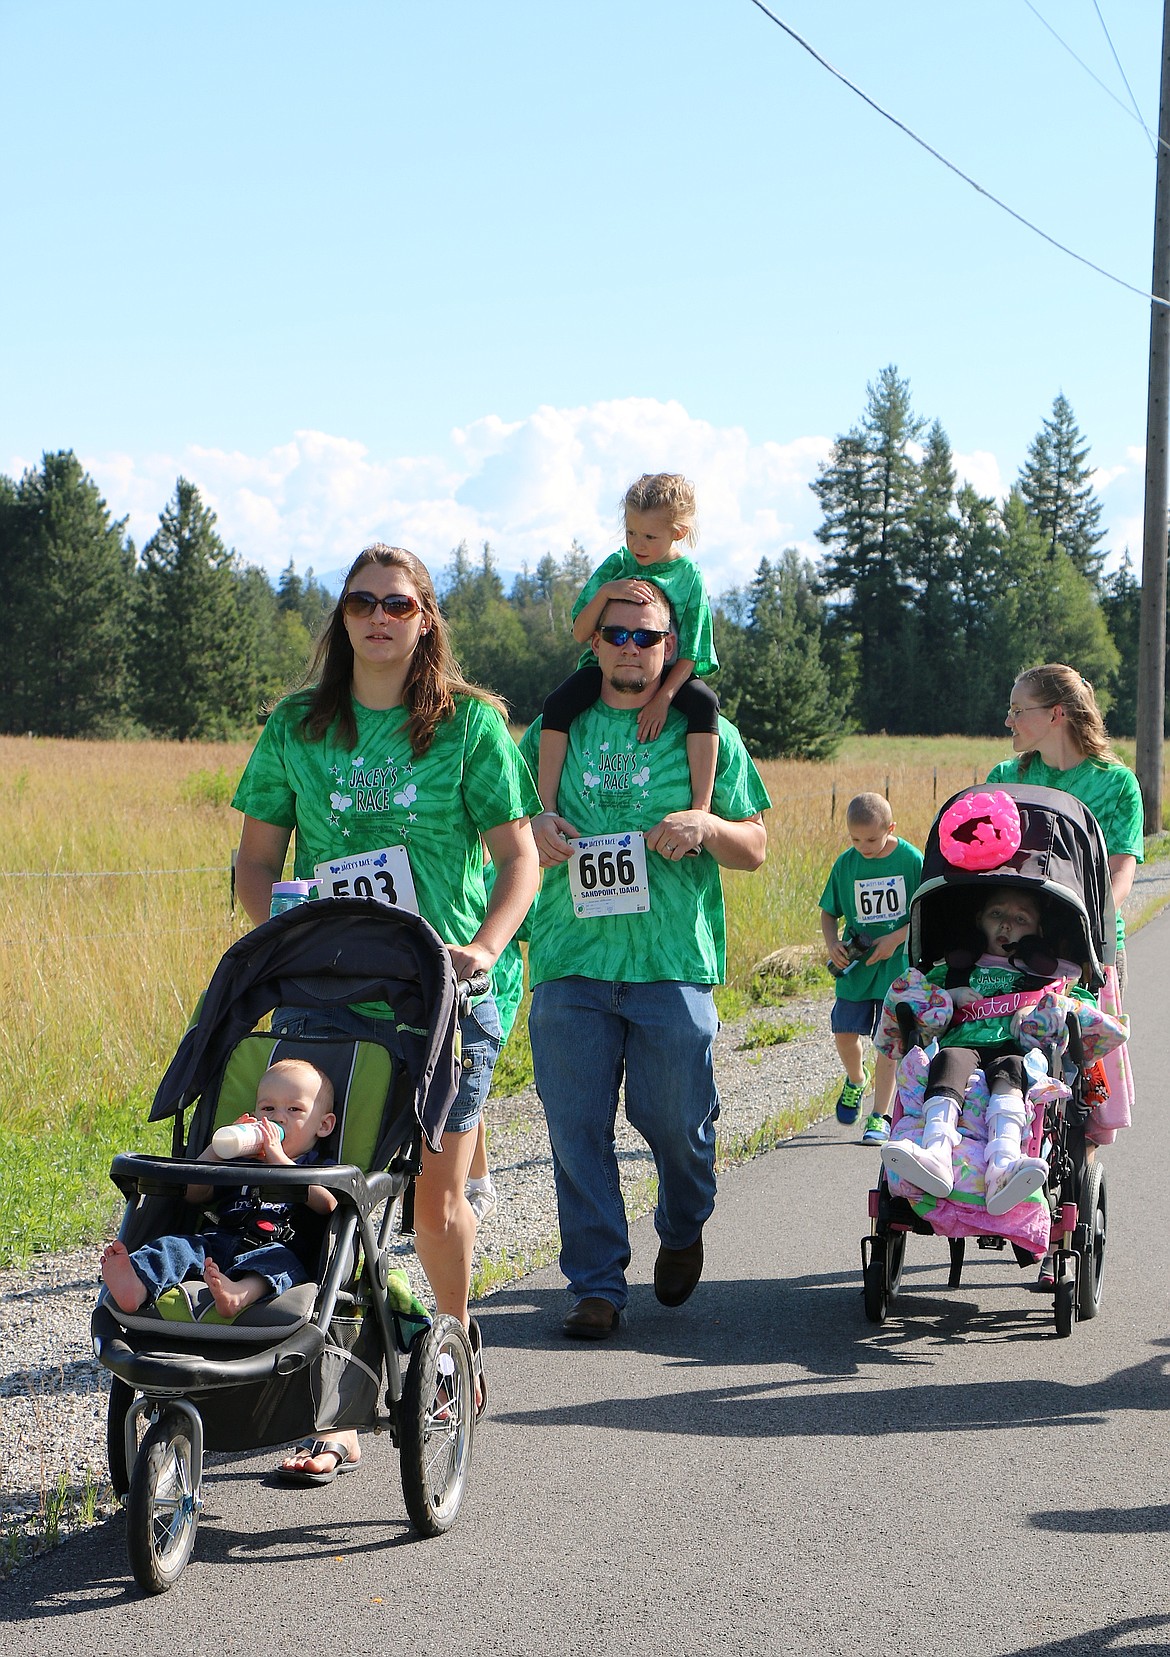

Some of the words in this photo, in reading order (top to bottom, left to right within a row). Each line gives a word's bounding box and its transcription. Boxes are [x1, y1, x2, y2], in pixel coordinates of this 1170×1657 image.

[598, 753, 636, 772] JACEY'S
[349, 766, 397, 788] JACEY'S
[603, 772, 630, 790] RACE
[356, 788, 390, 812] RACE
[579, 849, 635, 889] 666
[581, 888, 619, 898] SANDPOINT,
[619, 886, 640, 894] IDAHO
[860, 888, 899, 915] 670
